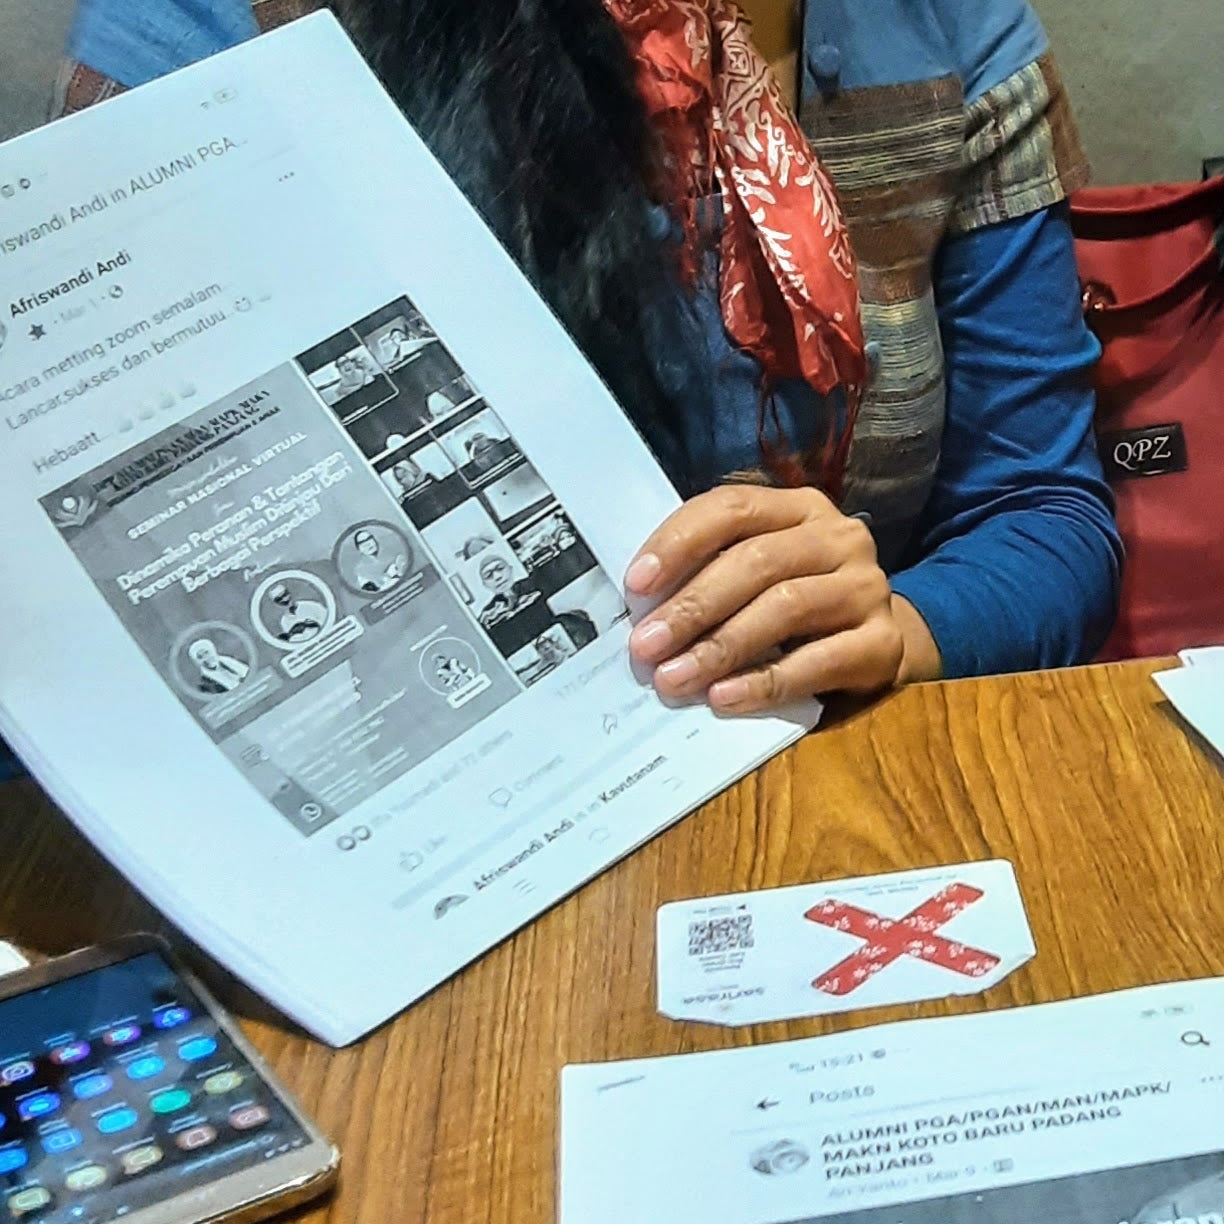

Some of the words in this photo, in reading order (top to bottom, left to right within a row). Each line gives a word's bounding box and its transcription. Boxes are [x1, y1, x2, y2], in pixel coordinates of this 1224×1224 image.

[68, 193, 108, 225] Andi
[111, 185, 128, 205] in
[129, 152, 197, 196] ALUMNI
[10, 269, 95, 319] Afriswandi
[96, 250, 132, 277] Andi
[42, 343, 106, 381] metting
[105, 319, 152, 349] zoom
[152, 282, 222, 325] semalam
[121, 347, 152, 371] dan
[1114, 436, 1172, 470] QPZ
[127, 499, 188, 540] SEMINAR
[187, 464, 252, 506] NASIONAL
[253, 432, 308, 467] VIRTUAL
[116, 543, 191, 590] Dinamika
[188, 506, 253, 547] Peranan
[252, 495, 268, 511] &
[128, 548, 216, 605] Perempuan
[213, 519, 269, 554] Muslim
[181, 546, 252, 592] Berbagai
[249, 502, 322, 551] Perspektif
[543, 819, 575, 843] Andi
[808, 1084, 876, 1105] Posts
[821, 1121, 908, 1147] ALUMNI
[823, 1142, 893, 1164] MAKN
[898, 1131, 959, 1150] KOTO
[965, 1122, 1025, 1141] BARU
[1031, 1106, 1123, 1131] PADANG
[825, 1153, 934, 1181] PANJANG
